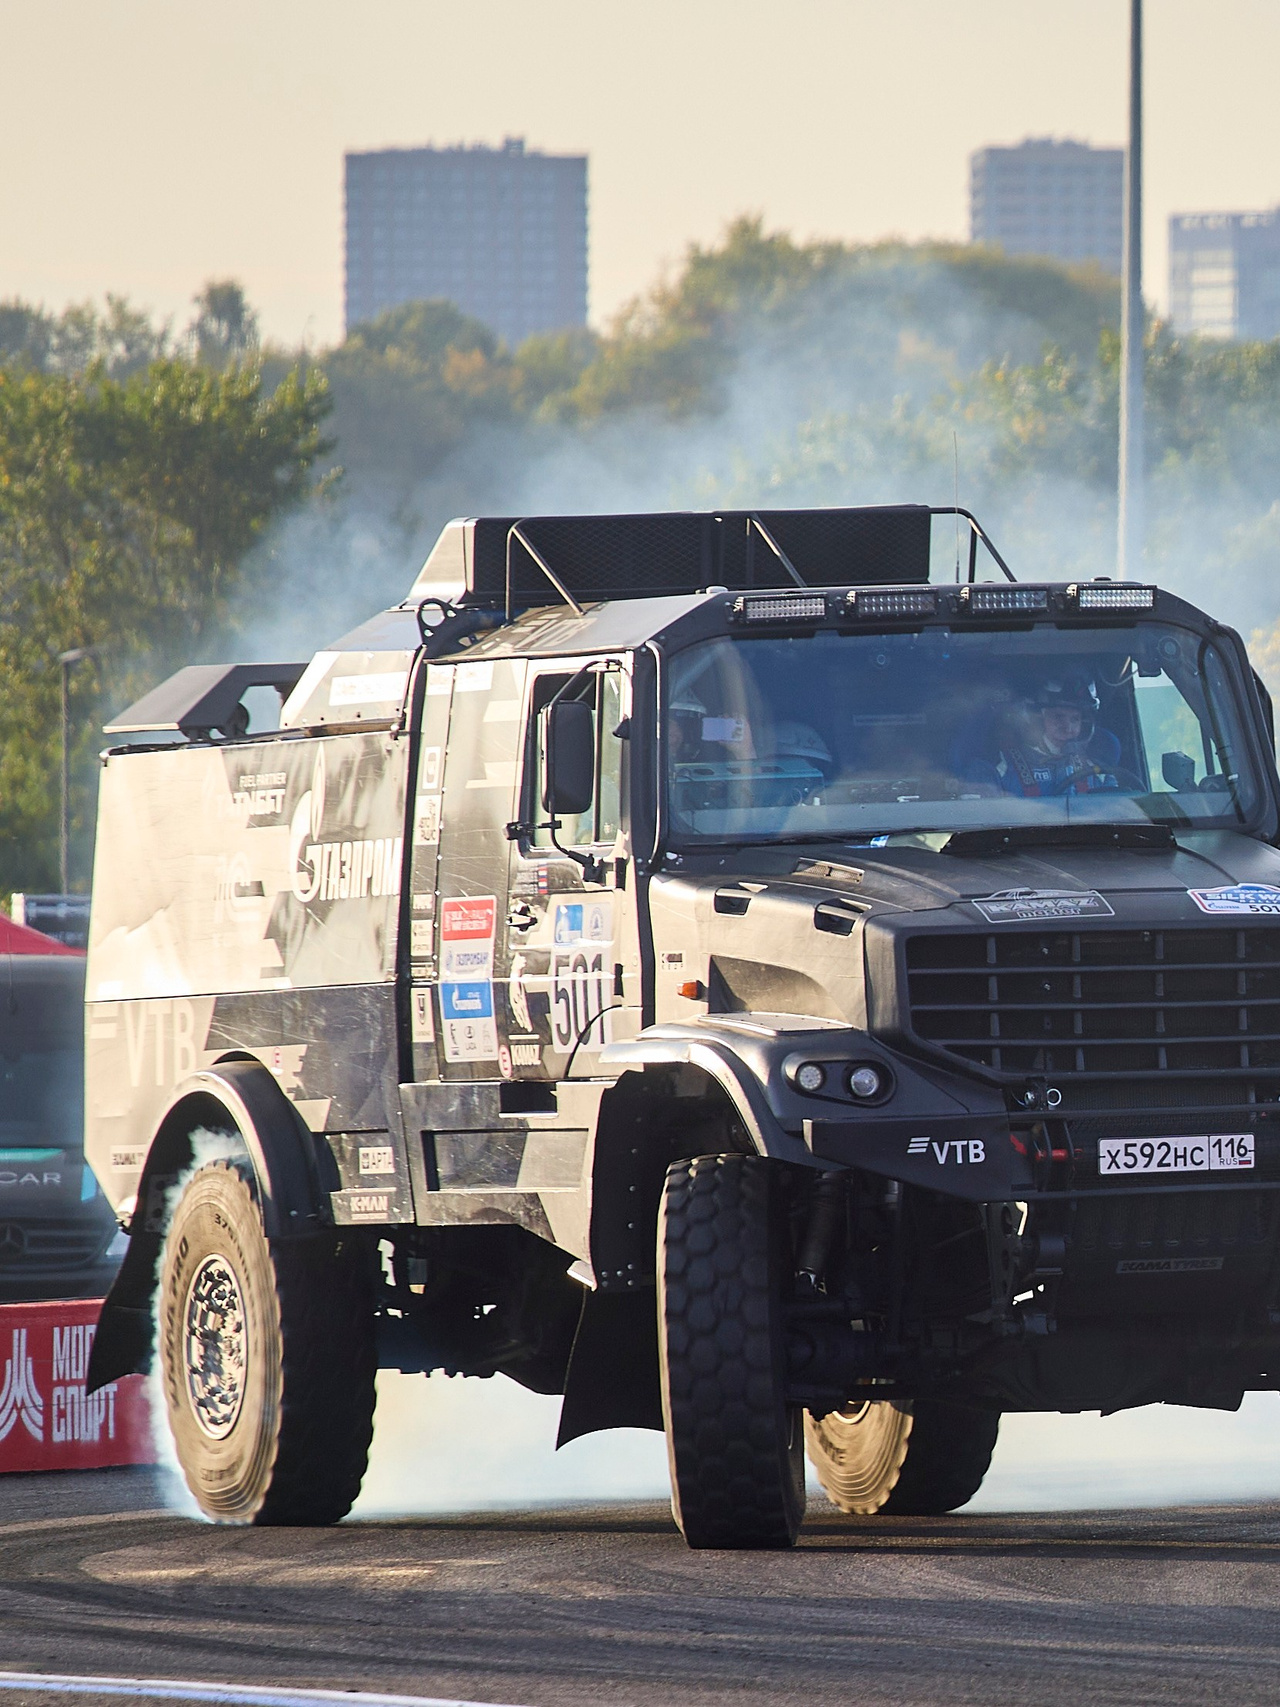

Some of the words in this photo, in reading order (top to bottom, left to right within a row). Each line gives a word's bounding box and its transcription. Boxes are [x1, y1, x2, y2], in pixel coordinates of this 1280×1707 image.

[319, 836, 402, 901] ГАЗПРОМ
[984, 896, 1099, 914] KAMAZ
[1016, 907, 1082, 918] master
[1248, 904, 1280, 913] 501
[554, 953, 605, 1047] 501
[121, 999, 197, 1088] VTB
[931, 1139, 987, 1165] VTB
[1211, 1137, 1248, 1160] 116
[1219, 1158, 1238, 1166] RUS
